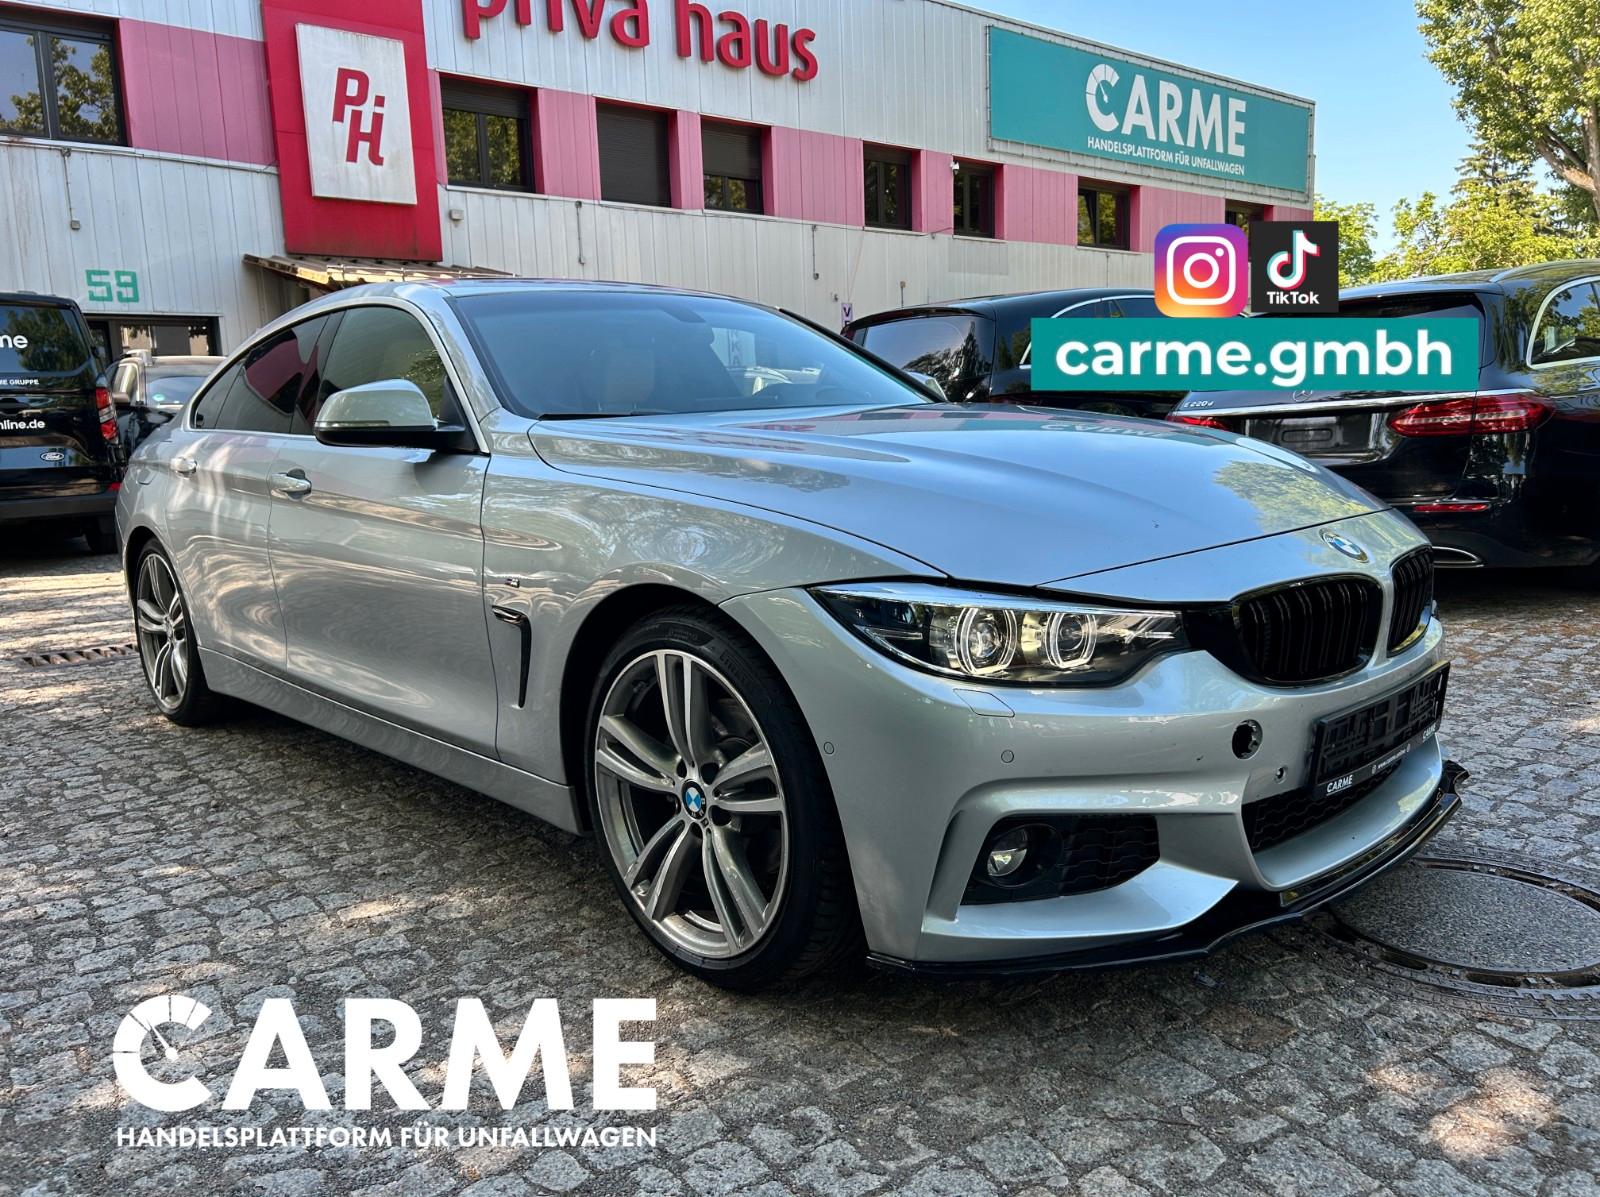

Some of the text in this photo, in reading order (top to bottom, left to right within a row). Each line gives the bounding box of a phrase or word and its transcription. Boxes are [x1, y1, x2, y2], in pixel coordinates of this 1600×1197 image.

[675, 0, 818, 81] haus
[1086, 64, 1246, 157] CARME
[1087, 136, 1245, 175] HANDELSPLATTFORM FÜR UNFALLWAGEN
[85, 269, 139, 303] 59
[1327, 775, 1352, 793] CARME
